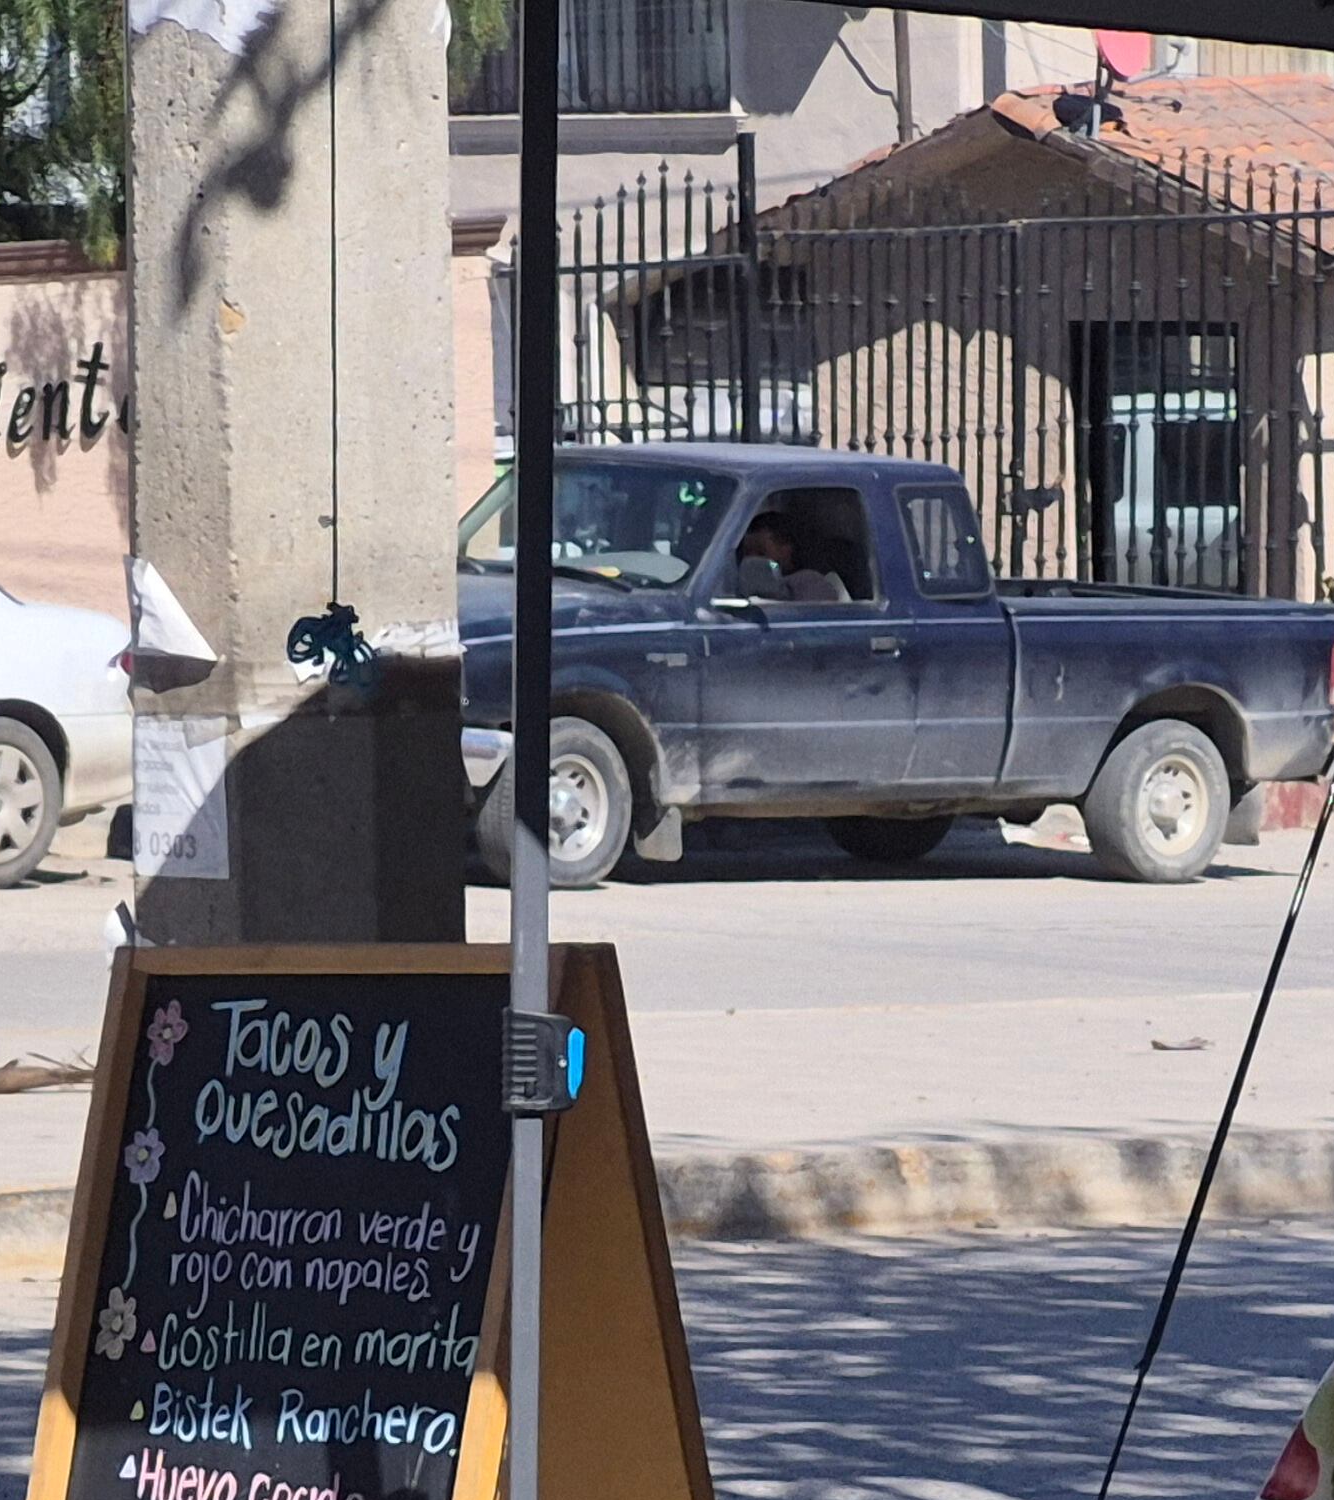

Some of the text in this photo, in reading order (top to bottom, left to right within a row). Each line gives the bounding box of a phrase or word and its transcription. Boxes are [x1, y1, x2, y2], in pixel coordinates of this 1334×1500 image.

[150, 831, 198, 860] 0303
[211, 998, 409, 1112] Tacos y
[195, 1079, 461, 1173] Quesadillas
[180, 1169, 481, 1283] Chicharron verde y
[169, 1250, 233, 1320] rojo
[240, 1251, 292, 1290] con
[158, 1302, 480, 1377] Costilla en morita
[148, 1377, 460, 1457] Bistek Ranchero.
